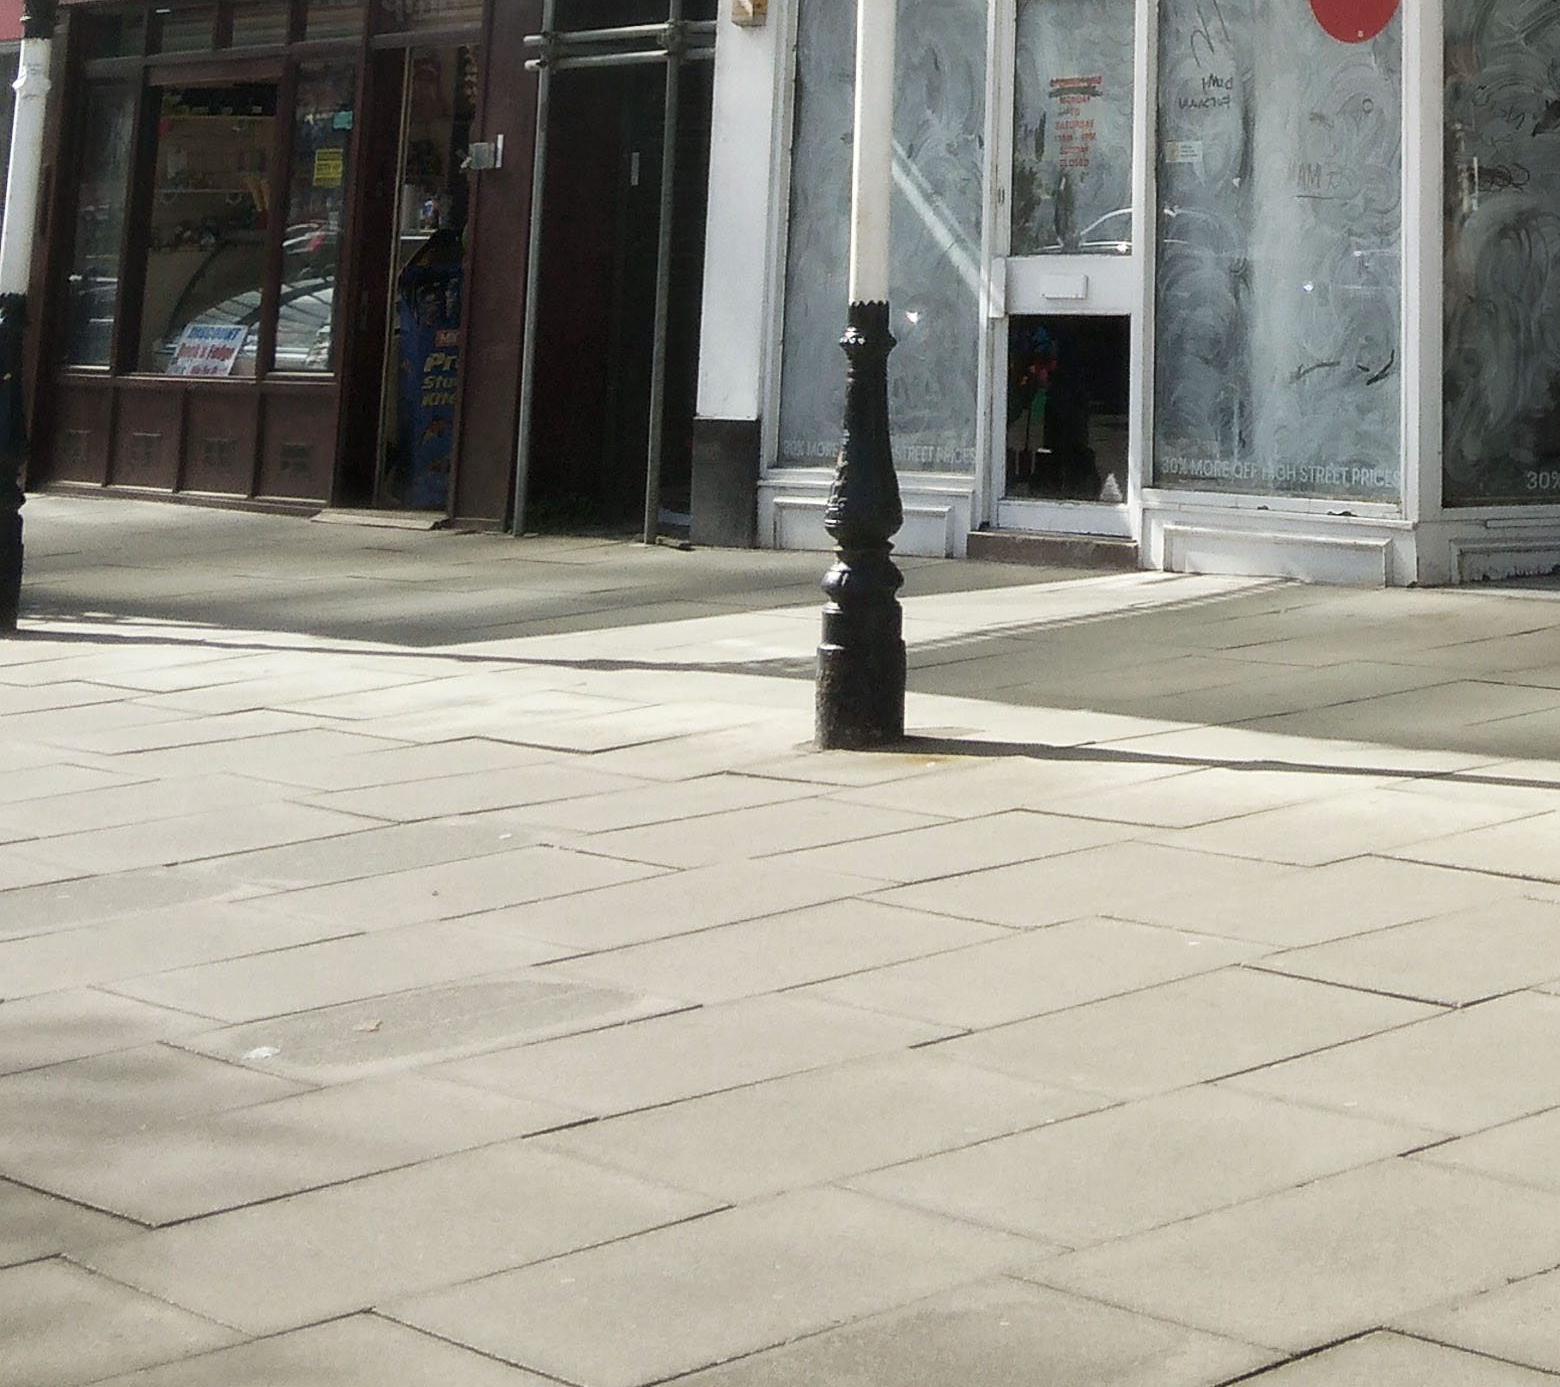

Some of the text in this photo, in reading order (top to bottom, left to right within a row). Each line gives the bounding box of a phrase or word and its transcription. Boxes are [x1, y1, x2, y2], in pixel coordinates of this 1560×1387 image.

[935, 445, 976, 464] PRICES
[1161, 458, 1400, 489] 30% MORE OFF HIGH STREET PRICES
